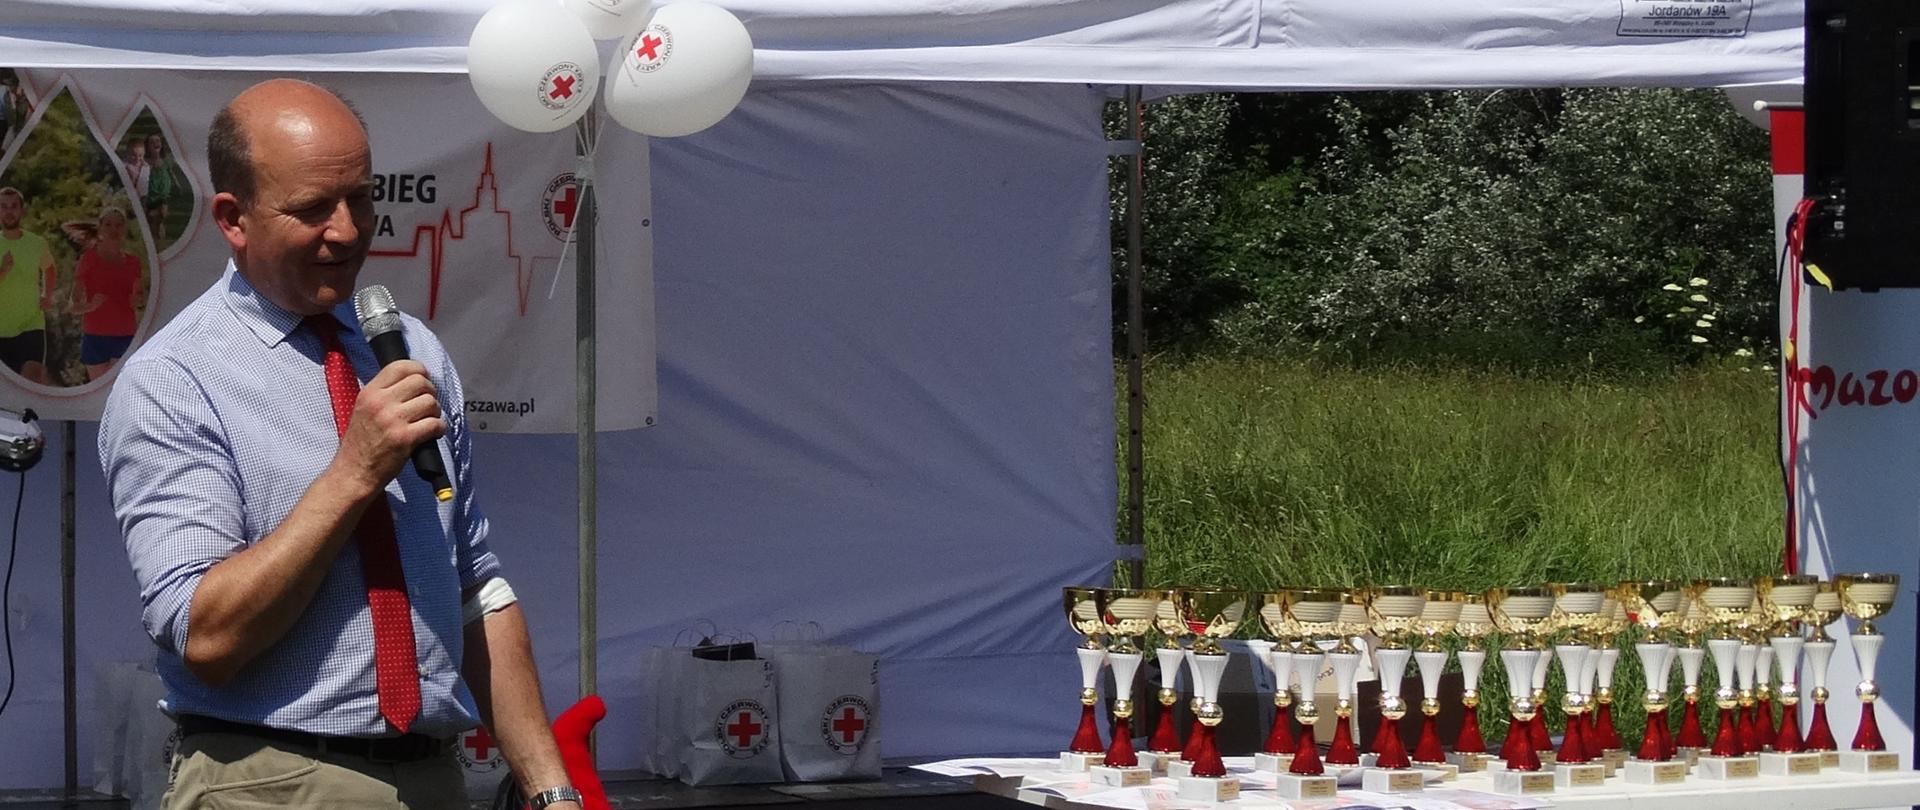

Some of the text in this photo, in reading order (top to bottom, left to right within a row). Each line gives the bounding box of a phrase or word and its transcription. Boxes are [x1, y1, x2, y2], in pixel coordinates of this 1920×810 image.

[1648, 5, 1726, 17] Jordanów 19A
[371, 174, 437, 204] BIEG
